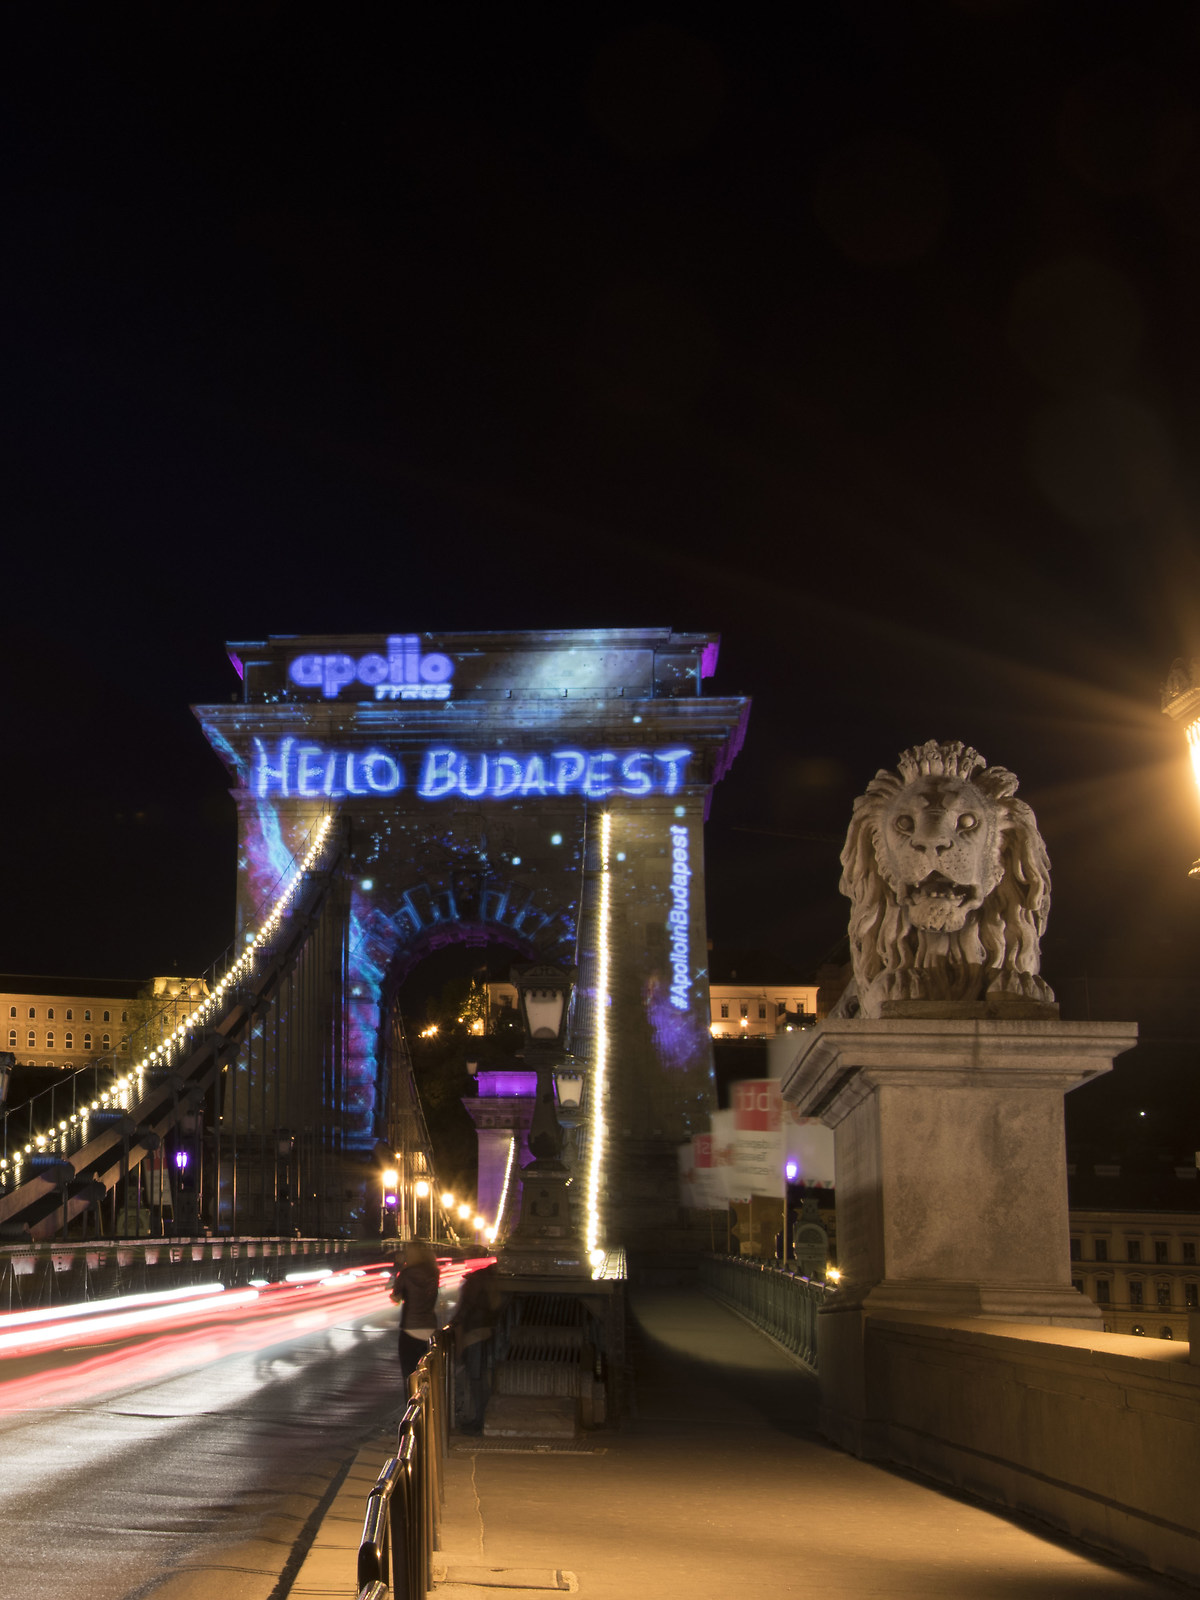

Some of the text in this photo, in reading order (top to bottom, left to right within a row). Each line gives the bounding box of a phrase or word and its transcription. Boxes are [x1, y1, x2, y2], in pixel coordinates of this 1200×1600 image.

[290, 634, 454, 698] apollo
[375, 683, 452, 700] TYRES
[253, 737, 692, 798] HELLO BUDAPEST
[669, 824, 692, 1010] #ApolloinBudapest
